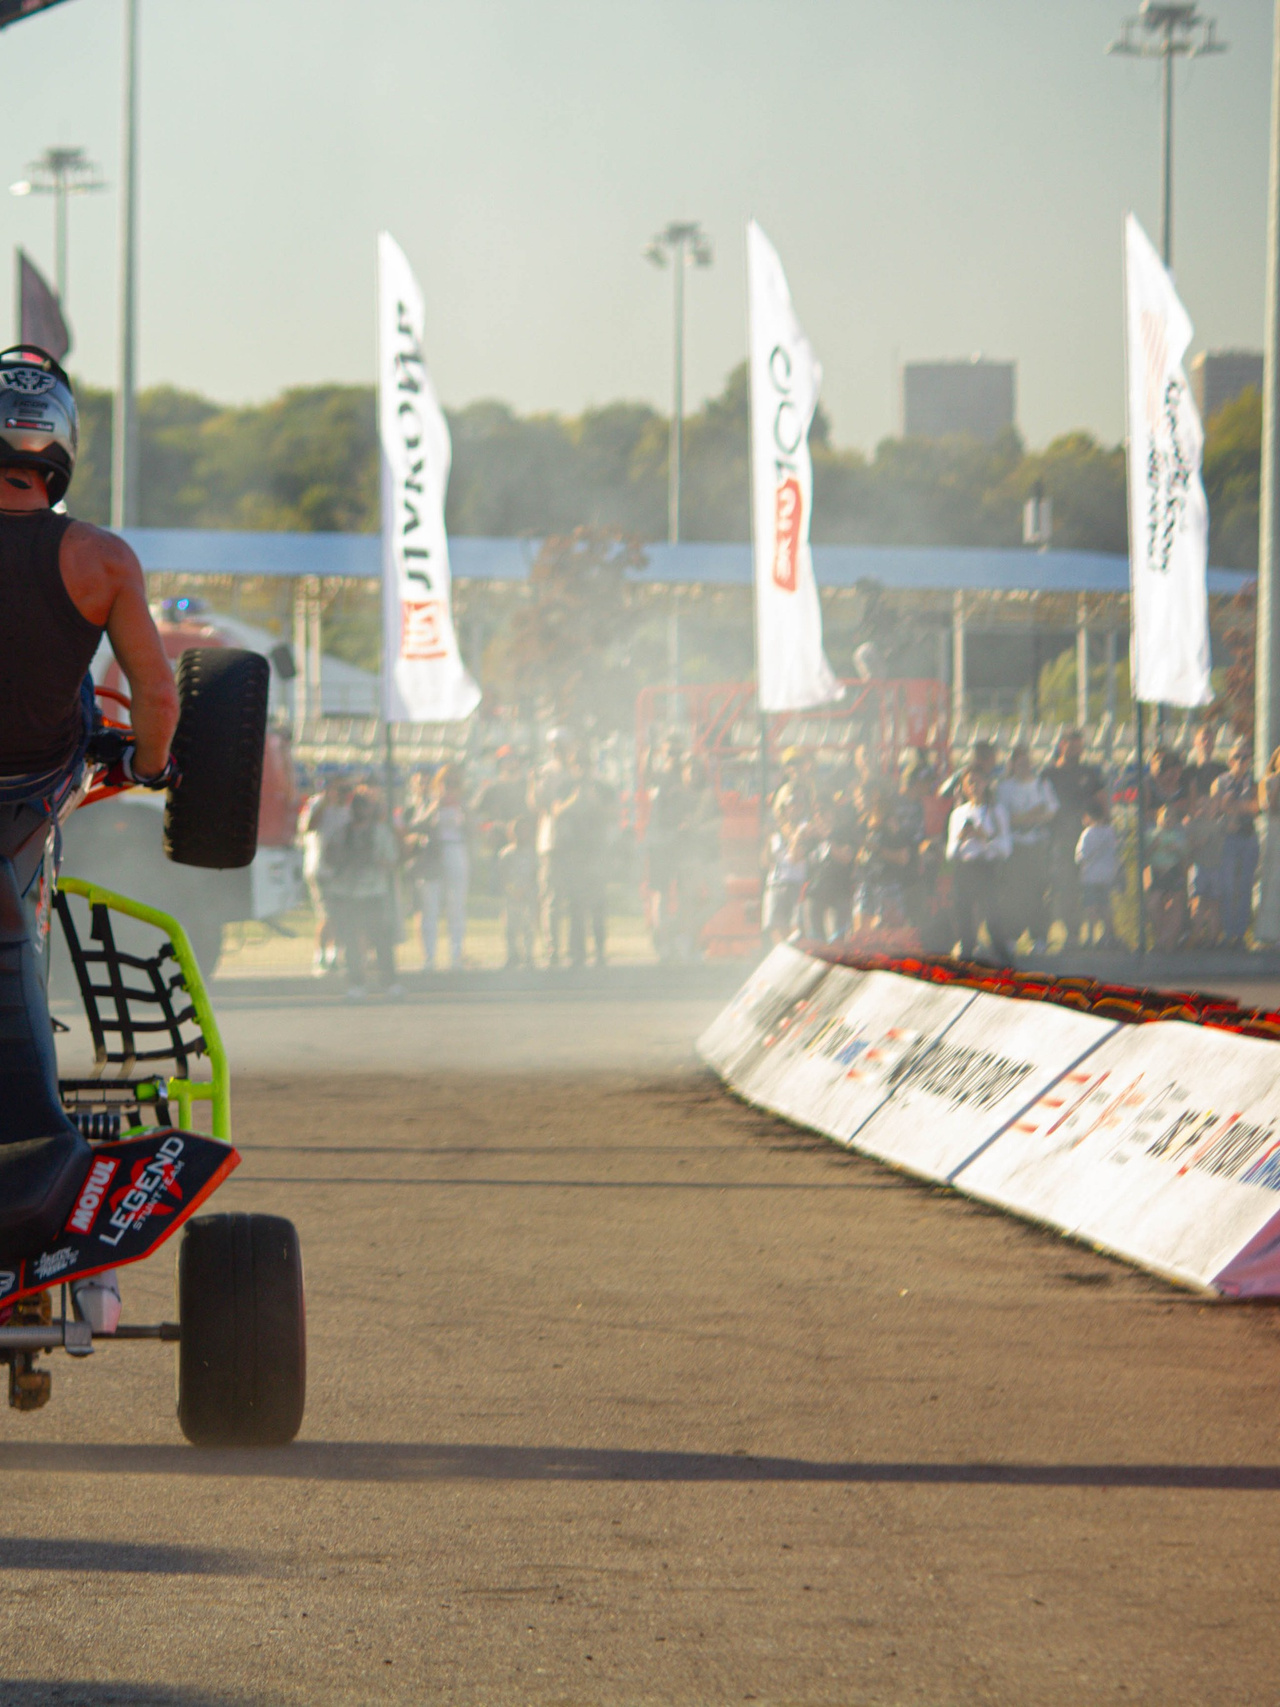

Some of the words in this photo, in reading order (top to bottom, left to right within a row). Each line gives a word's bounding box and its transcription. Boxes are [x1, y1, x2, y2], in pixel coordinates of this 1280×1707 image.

[70, 1159, 116, 1231] MOTUL
[99, 1136, 185, 1246] LEGEND
[132, 1192, 163, 1231] STUNT
[158, 1160, 186, 1194] TEAM
